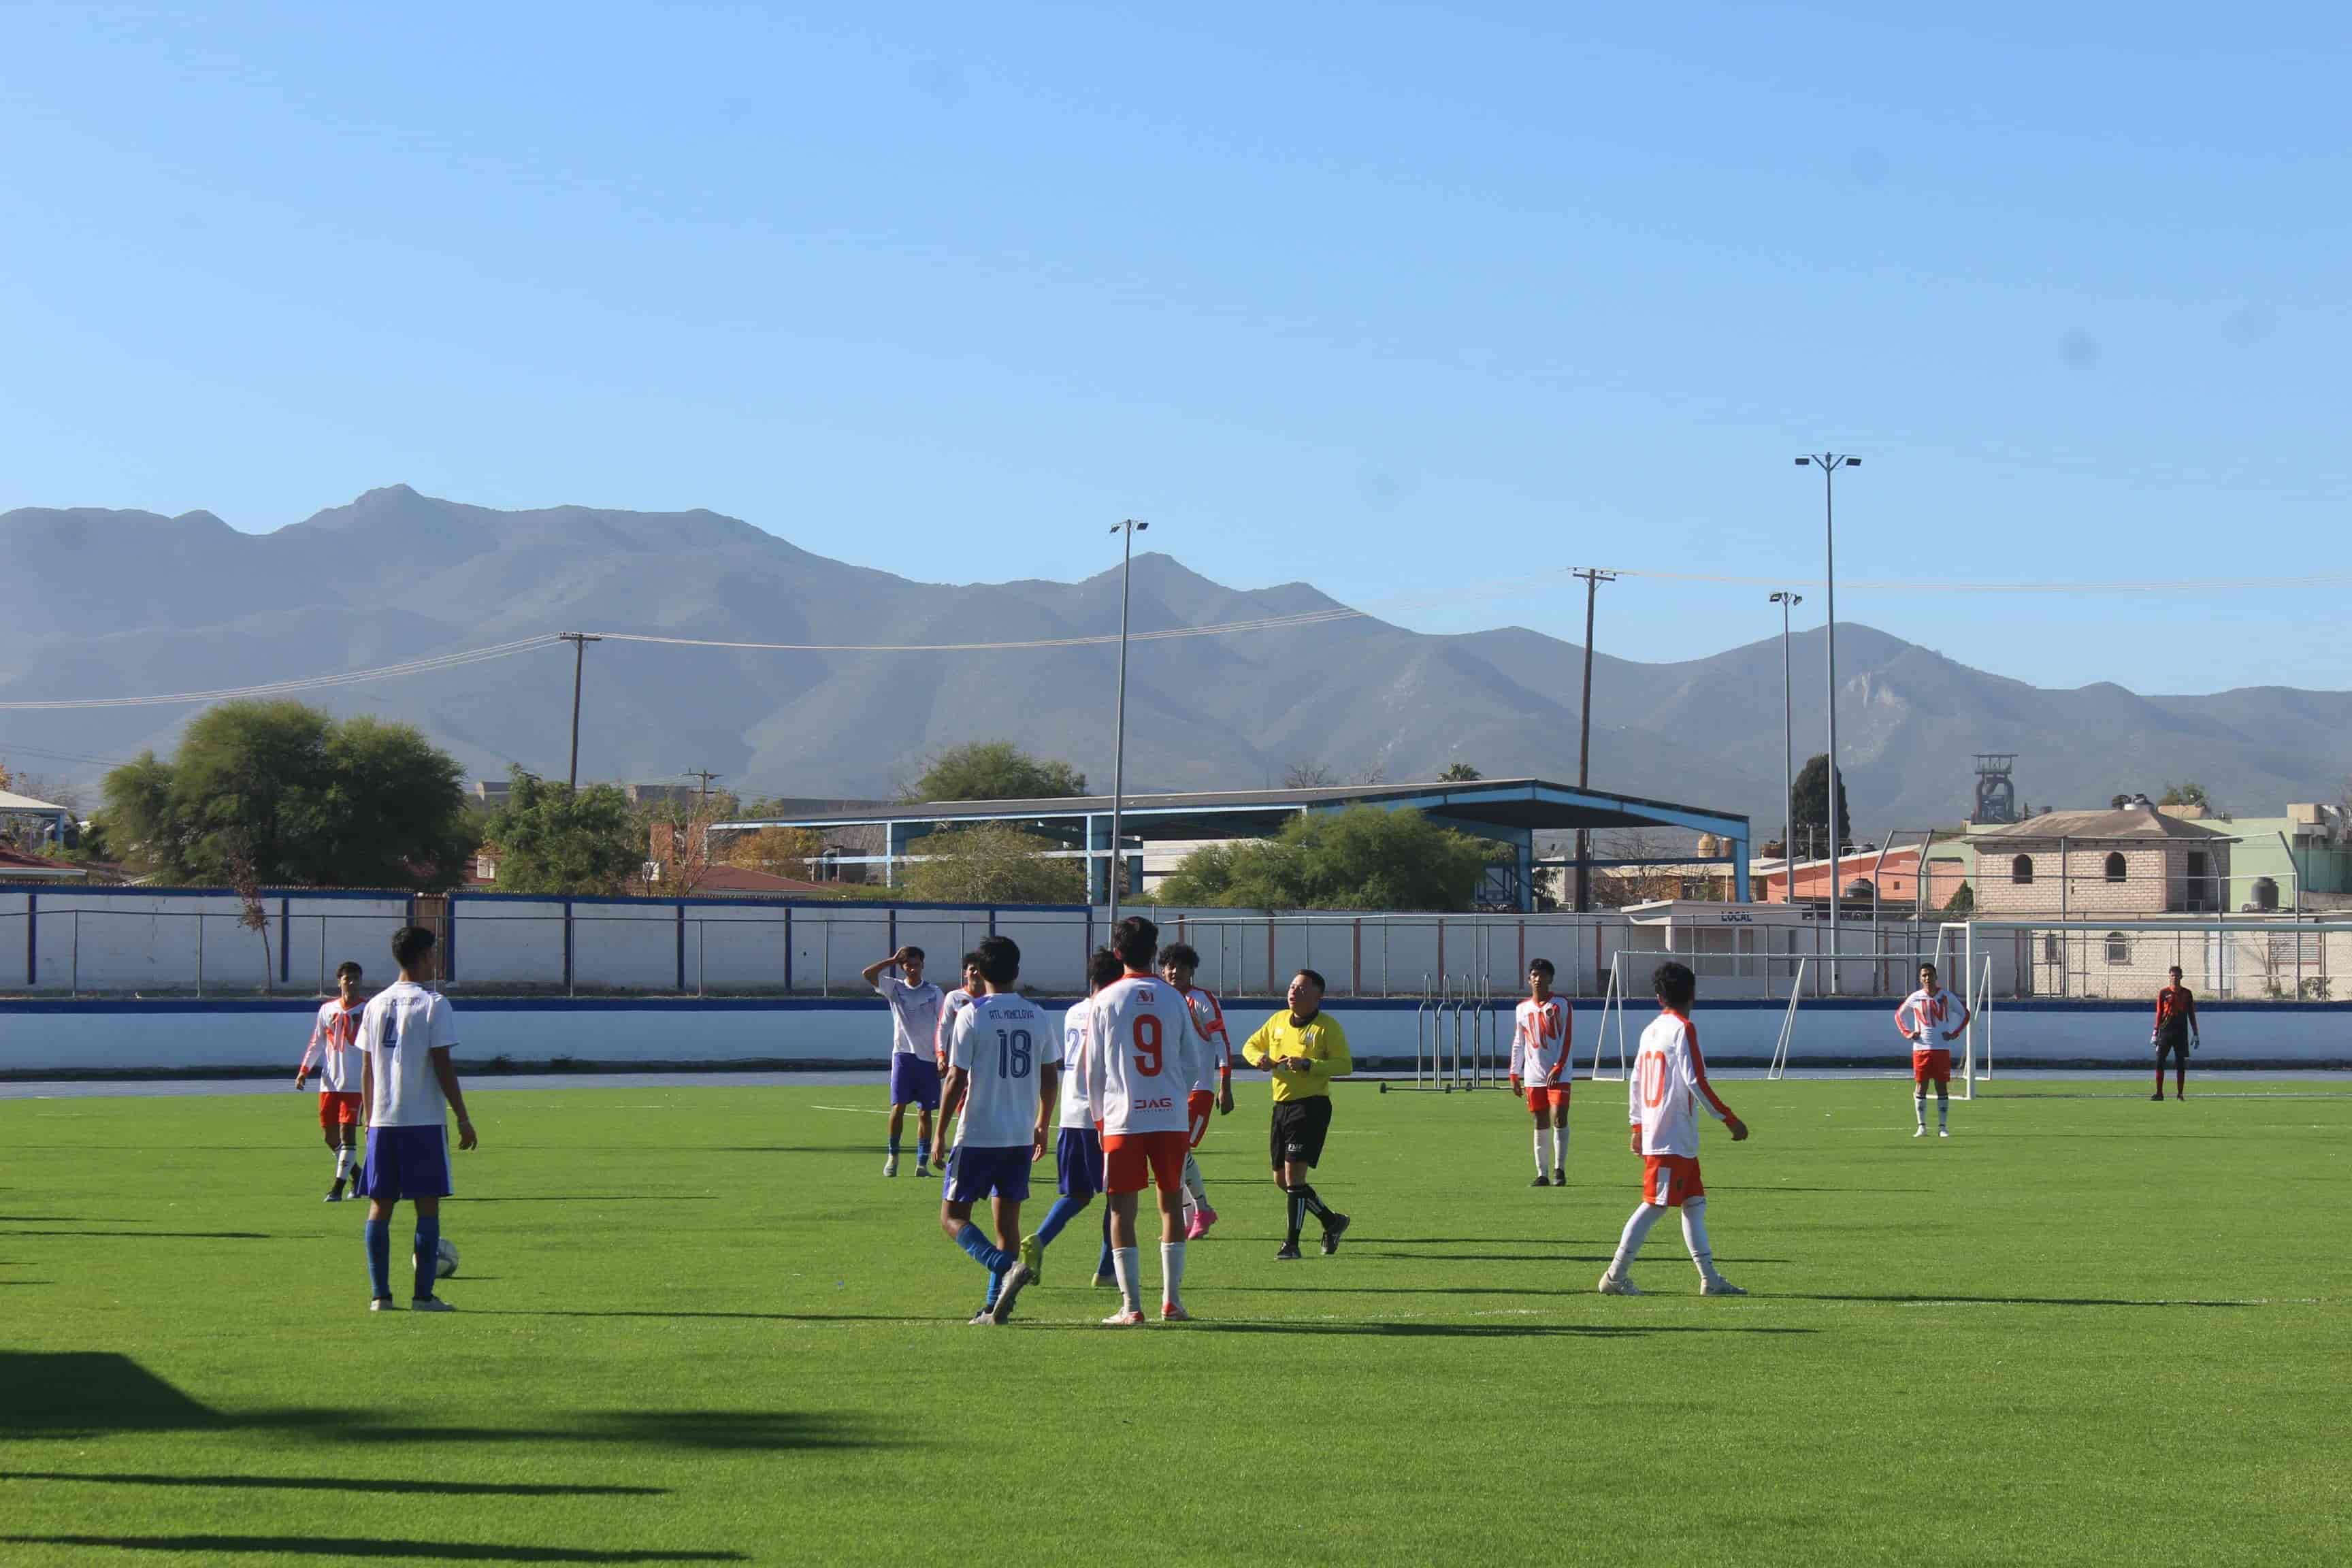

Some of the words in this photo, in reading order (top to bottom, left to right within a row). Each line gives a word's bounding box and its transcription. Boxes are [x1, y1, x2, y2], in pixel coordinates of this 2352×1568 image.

[1721, 911, 1752, 921] LOCAL
[996, 1028, 1032, 1079] 18
[1133, 1013, 1163, 1077] 9
